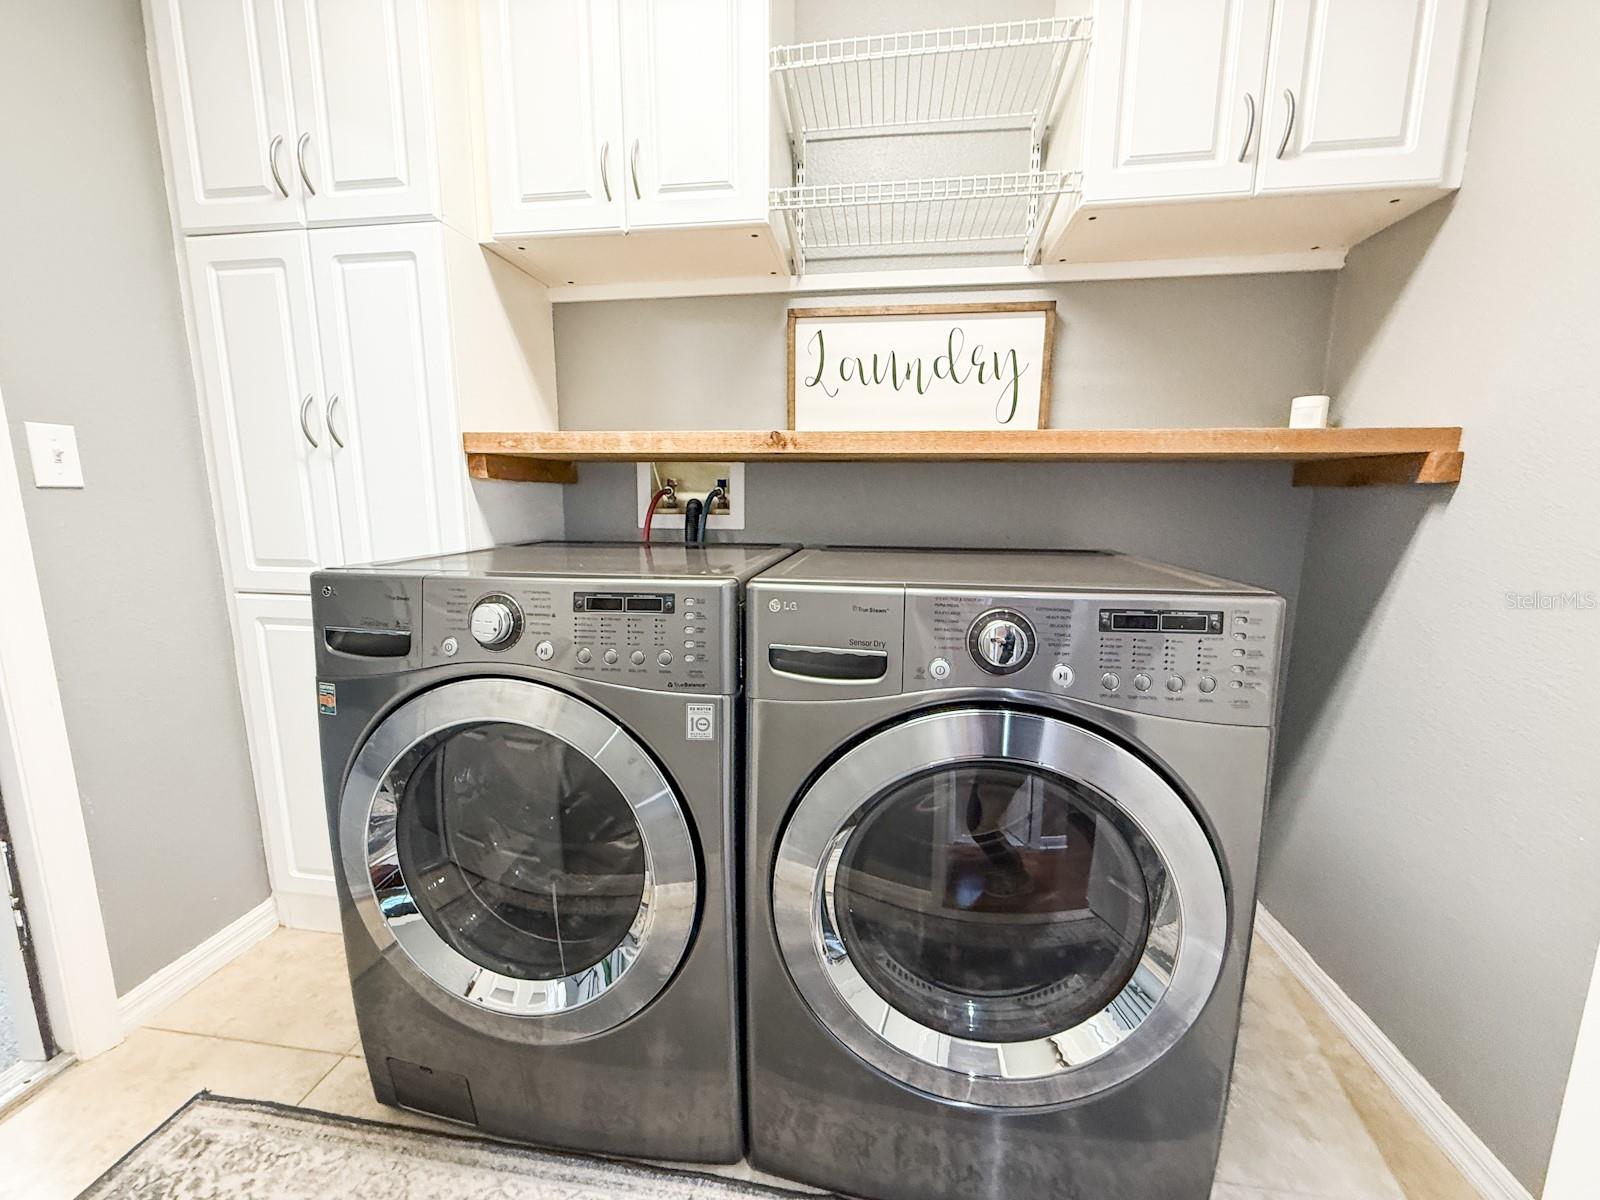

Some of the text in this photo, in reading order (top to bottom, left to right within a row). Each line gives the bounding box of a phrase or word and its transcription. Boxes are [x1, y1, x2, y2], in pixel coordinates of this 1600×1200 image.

[804, 327, 1029, 424] Laundry
[783, 601, 798, 611] LG
[848, 638, 887, 649] Sensor Dry
[690, 717, 711, 732] 10
